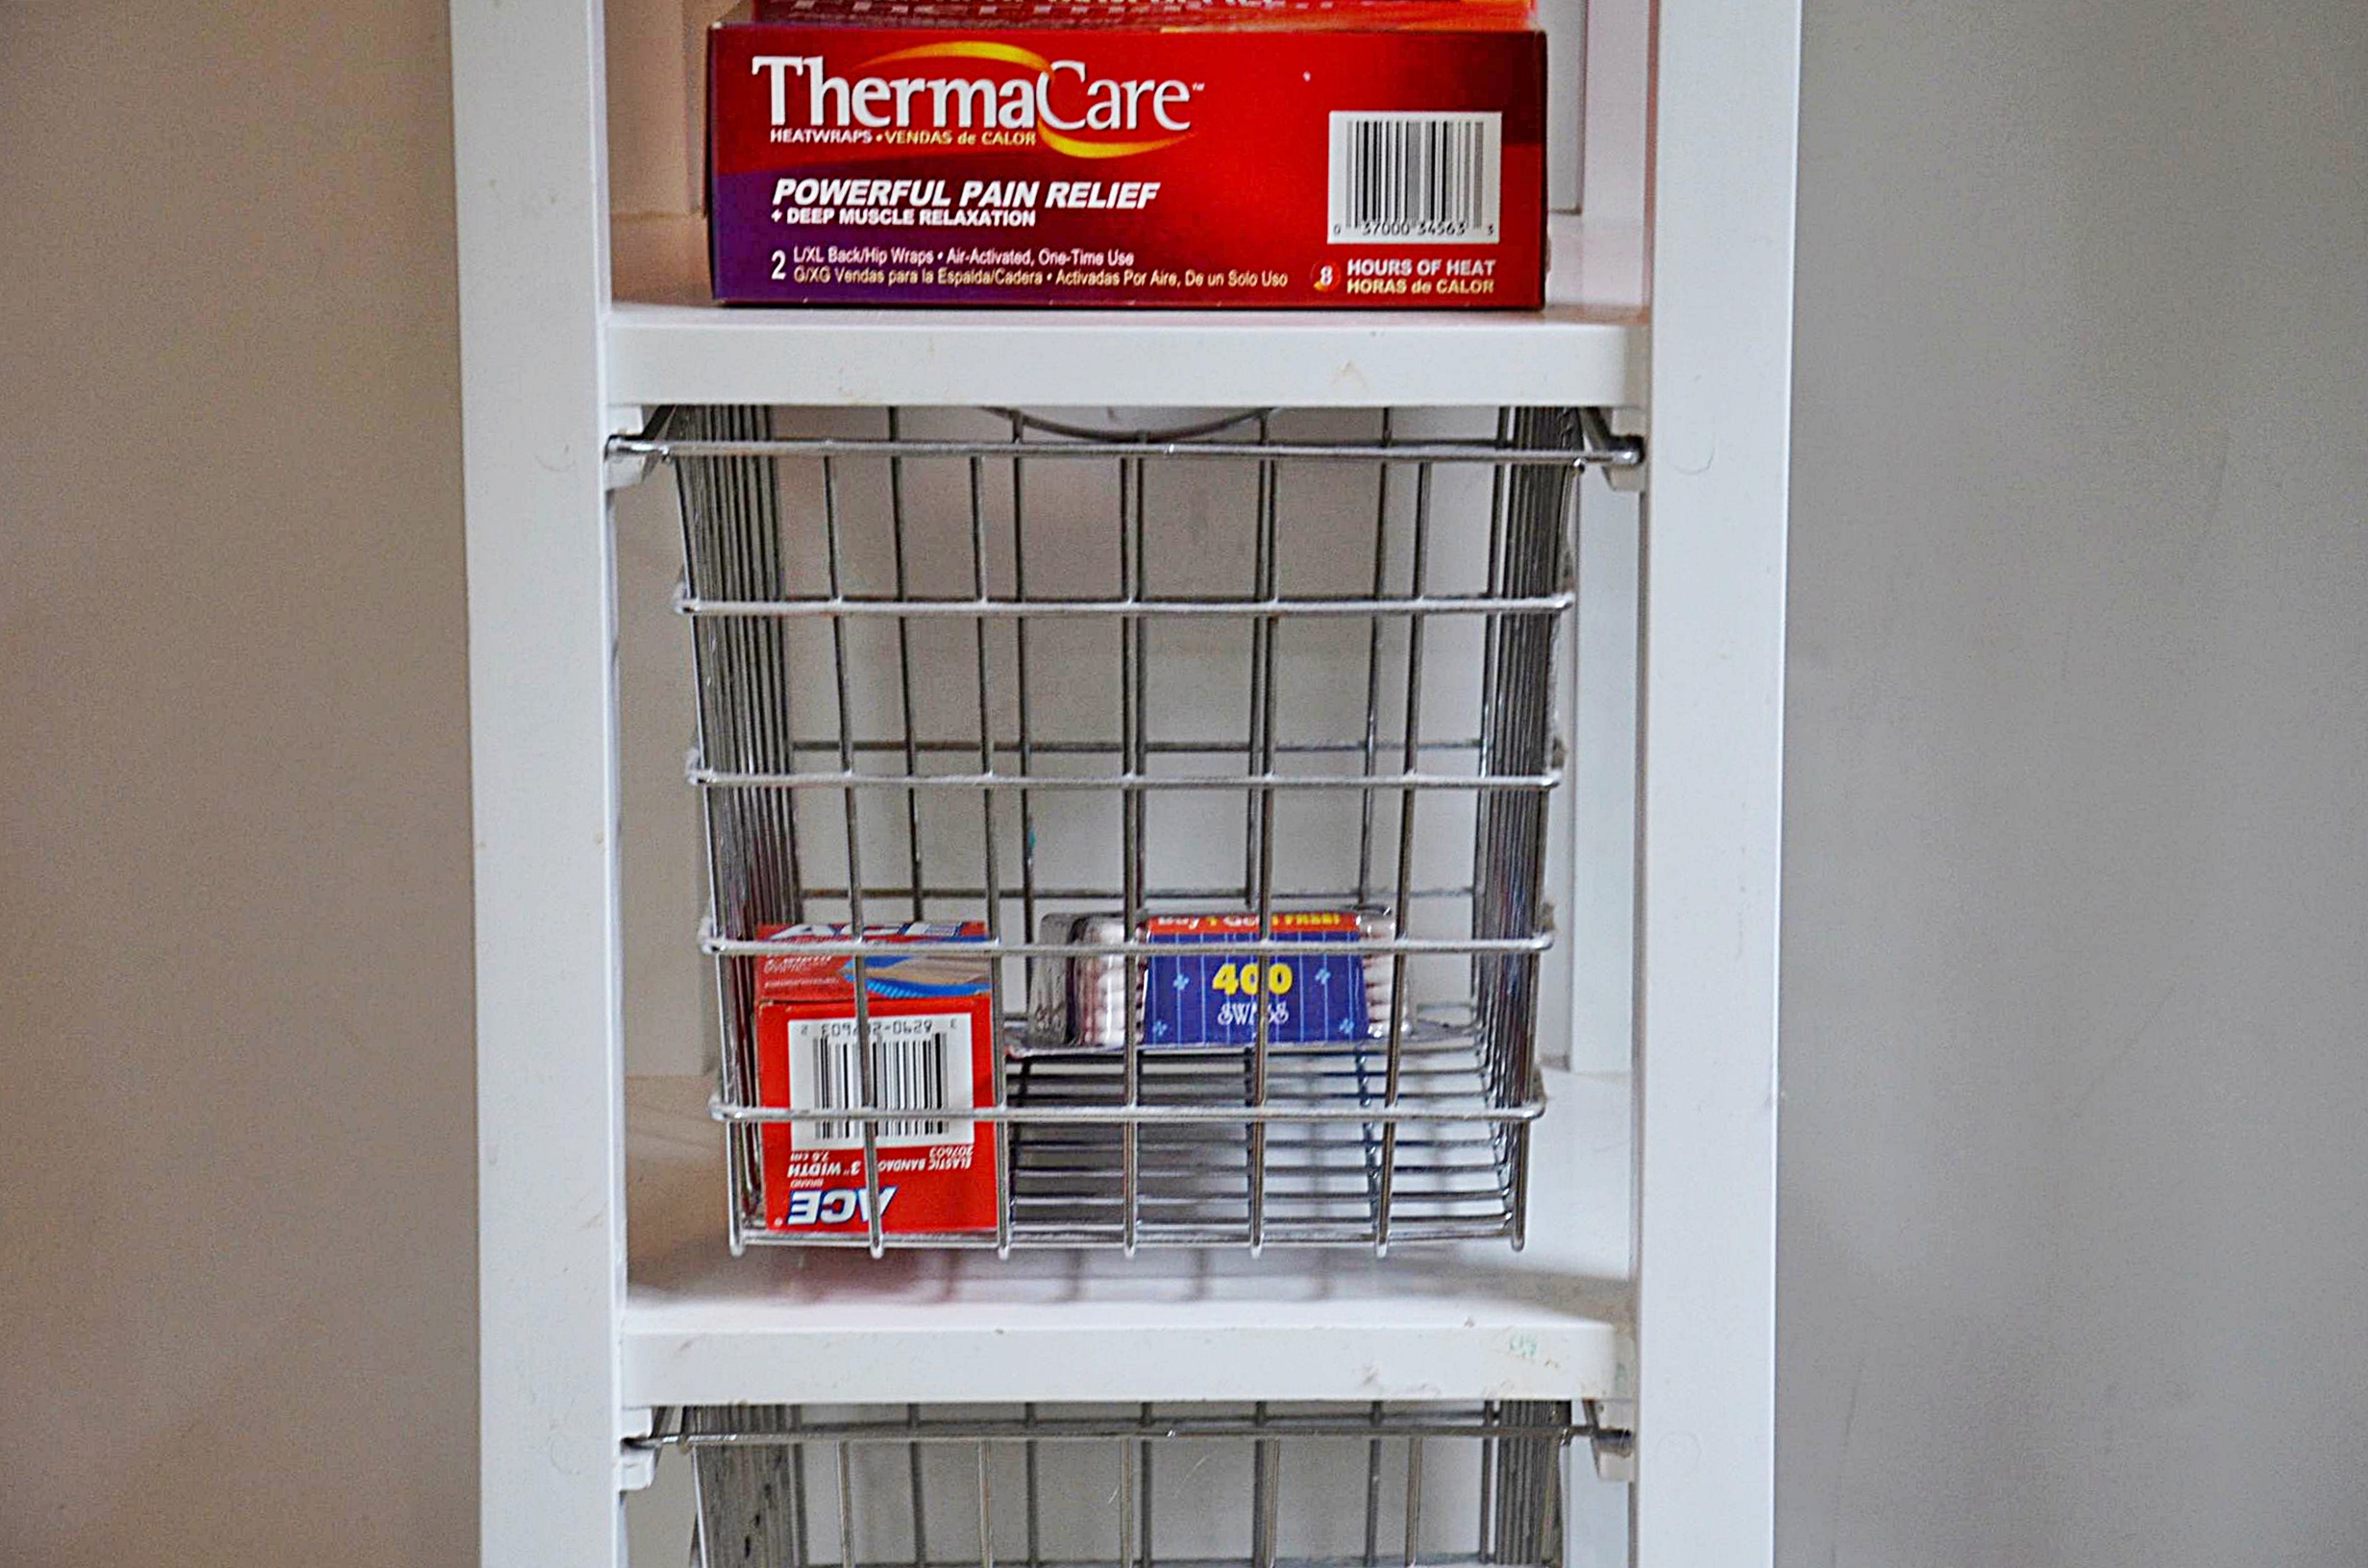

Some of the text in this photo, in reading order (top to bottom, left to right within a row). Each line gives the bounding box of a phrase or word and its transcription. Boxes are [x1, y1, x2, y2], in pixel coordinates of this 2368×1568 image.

[752, 56, 1192, 131] ThermaCare
[770, 128, 1036, 146] HEATWRAPS VENDAS de CALOR
[772, 179, 1161, 209] POWERFUL PAIN RELIEF
[786, 208, 834, 225] DEEP
[838, 208, 915, 226] MUSCLE
[919, 208, 1036, 227] RELAXATION
[771, 249, 787, 281] 2
[793, 245, 1135, 267] L/XL Back/Hip Wraps Air-Activated, One-Time Use
[1346, 257, 1497, 277] HOURS OF HEAT
[834, 266, 885, 283] Vendas
[888, 268, 919, 287] para
[922, 267, 934, 284] la
[1055, 268, 1121, 286] Activadas
[1123, 269, 1147, 286] Por
[1149, 269, 1181, 288] Aire,
[1185, 269, 1204, 286] De
[1207, 272, 1224, 286] un
[1228, 269, 1259, 287] Solo
[1262, 270, 1289, 287] Uso
[1320, 264, 1334, 286] 8
[1346, 278, 1495, 295] HORAS de CALOR
[1212, 963, 1294, 996] 400
[787, 1162, 842, 1178] WIDTH
[876, 1156, 973, 1172] ELASTIC BANDAG
[786, 1186, 899, 1225] ACE
